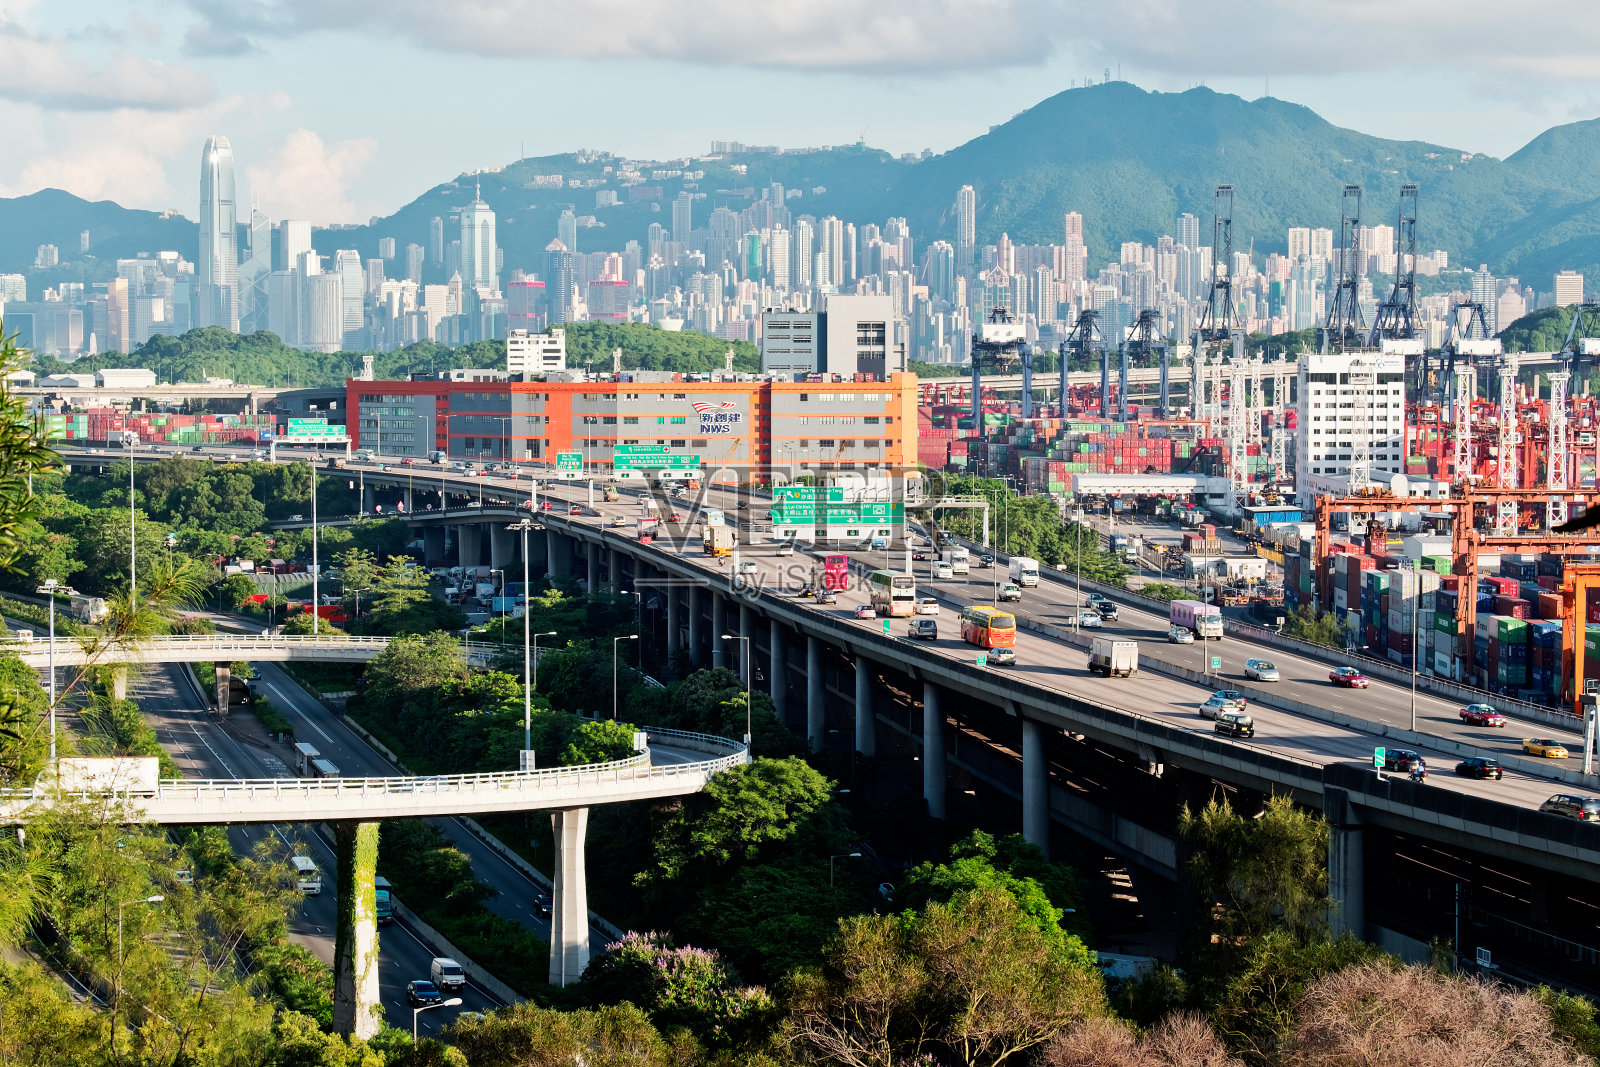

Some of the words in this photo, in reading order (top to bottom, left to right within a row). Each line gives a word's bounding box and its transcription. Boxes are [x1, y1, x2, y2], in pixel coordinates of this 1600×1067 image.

[702, 412, 742, 424] 新創建
[701, 424, 731, 433] NWS
